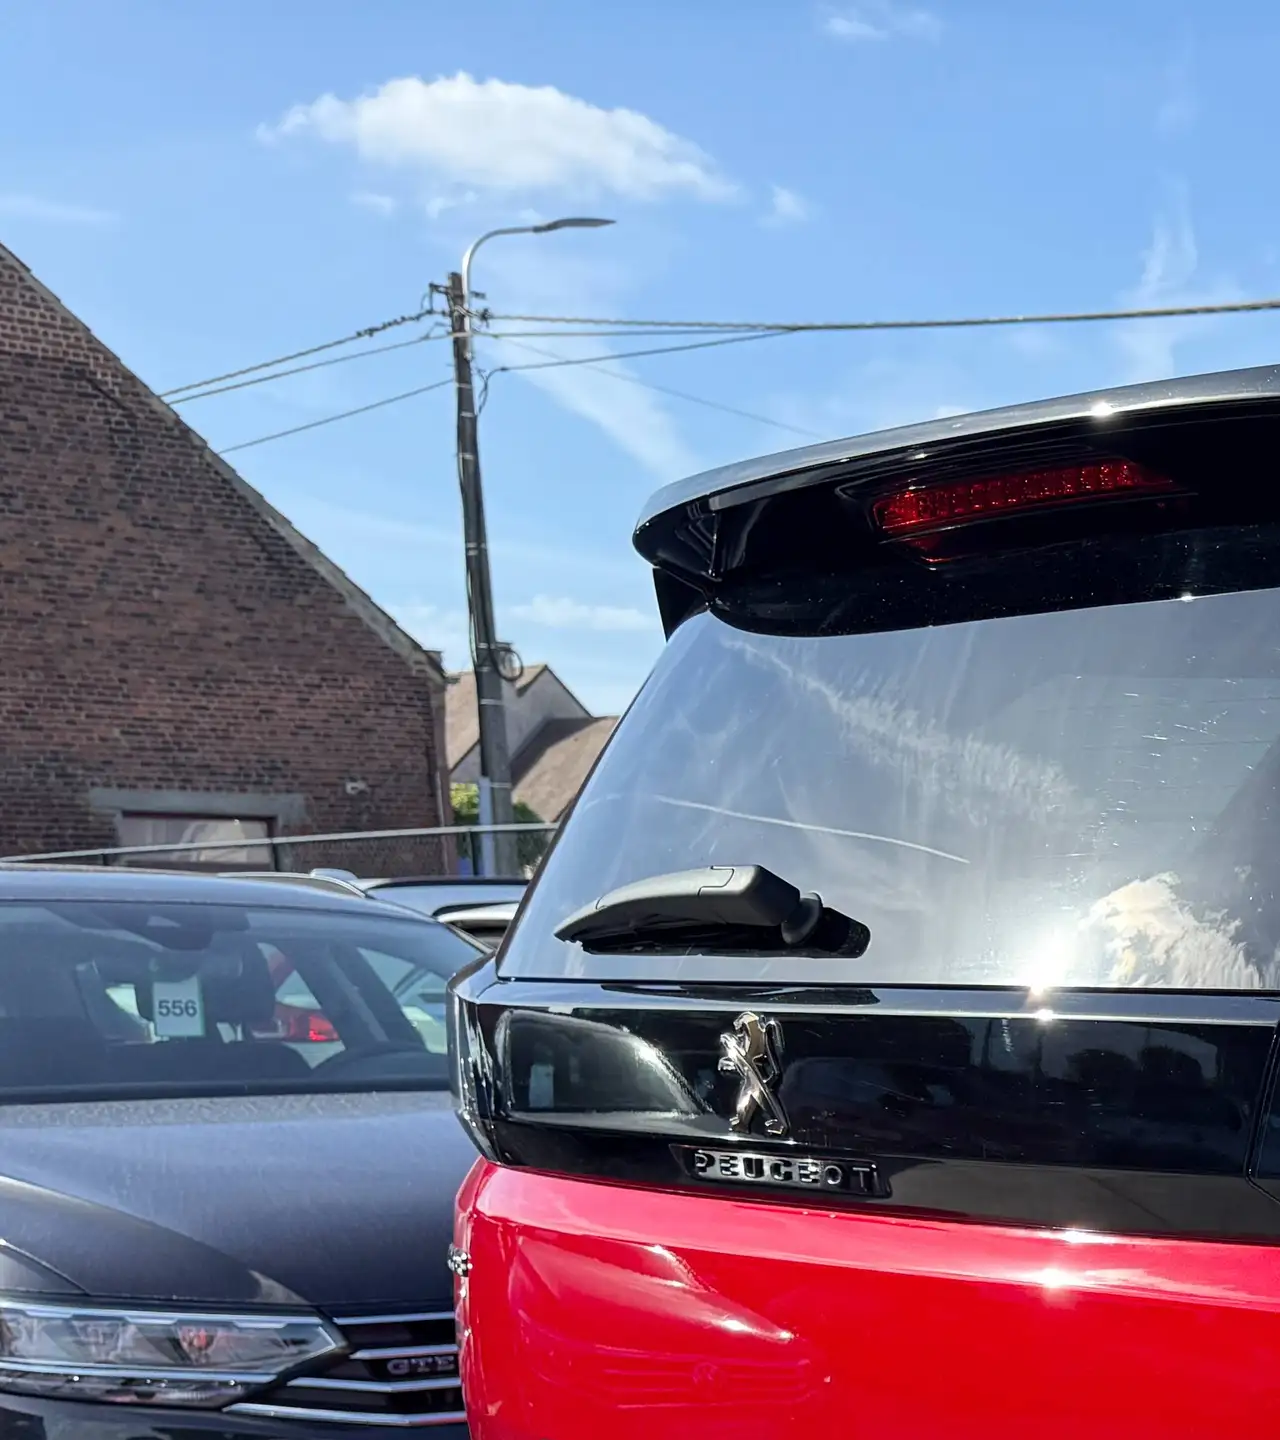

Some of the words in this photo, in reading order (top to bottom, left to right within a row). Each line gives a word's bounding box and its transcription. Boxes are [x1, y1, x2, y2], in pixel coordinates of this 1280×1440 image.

[158, 998, 198, 1018] 556
[693, 1148, 872, 1193] PEUGEOT
[386, 1354, 455, 1375] GTE
